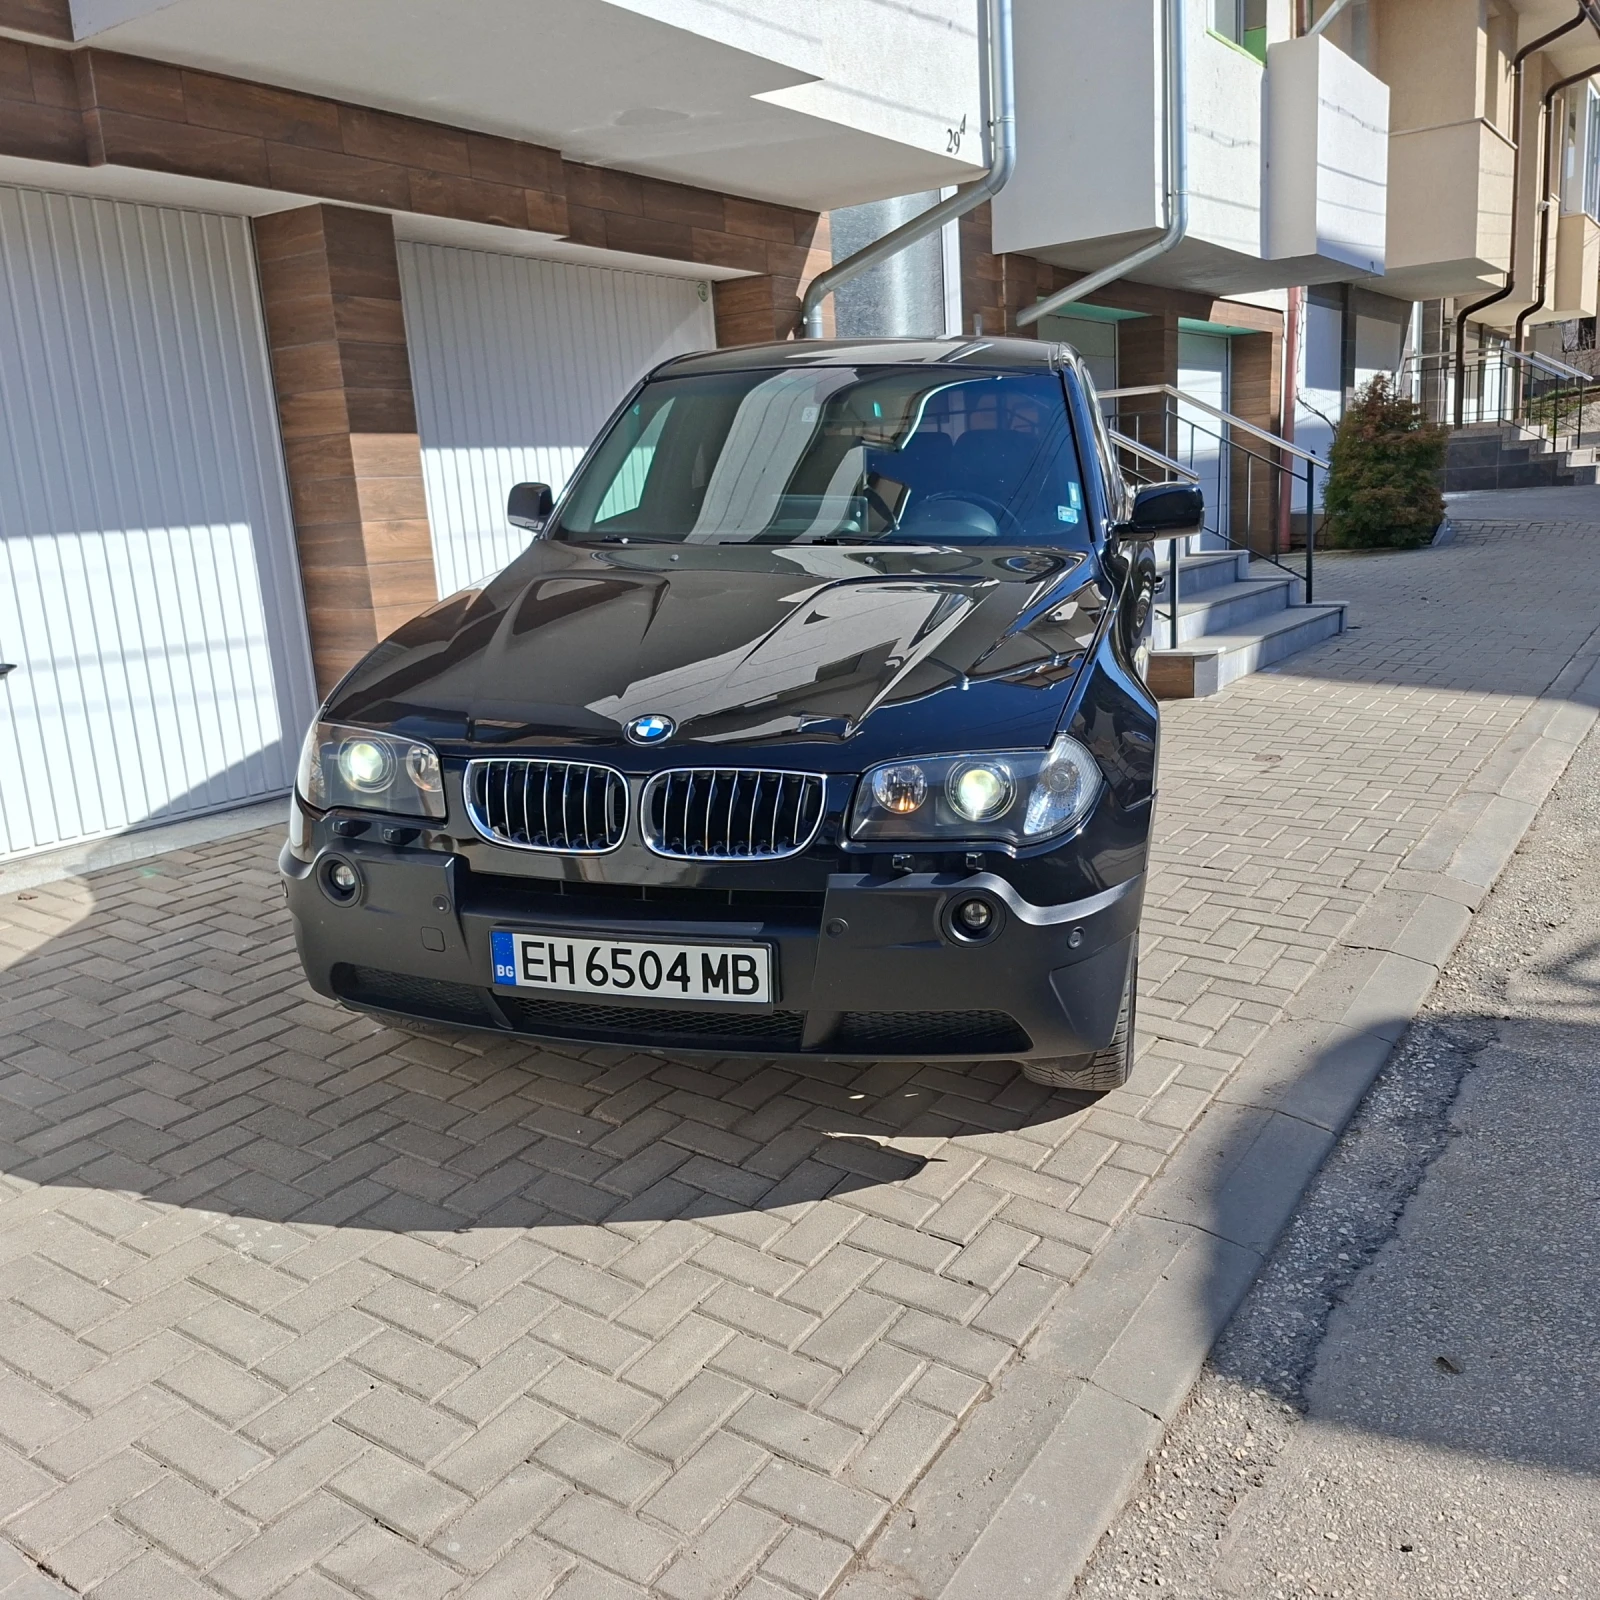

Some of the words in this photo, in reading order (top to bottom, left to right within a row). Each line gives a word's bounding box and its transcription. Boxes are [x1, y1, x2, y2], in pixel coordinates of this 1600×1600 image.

[497, 964, 514, 977] BG
[521, 940, 576, 985] EH
[585, 947, 690, 992] 6504
[701, 953, 760, 995] MB
